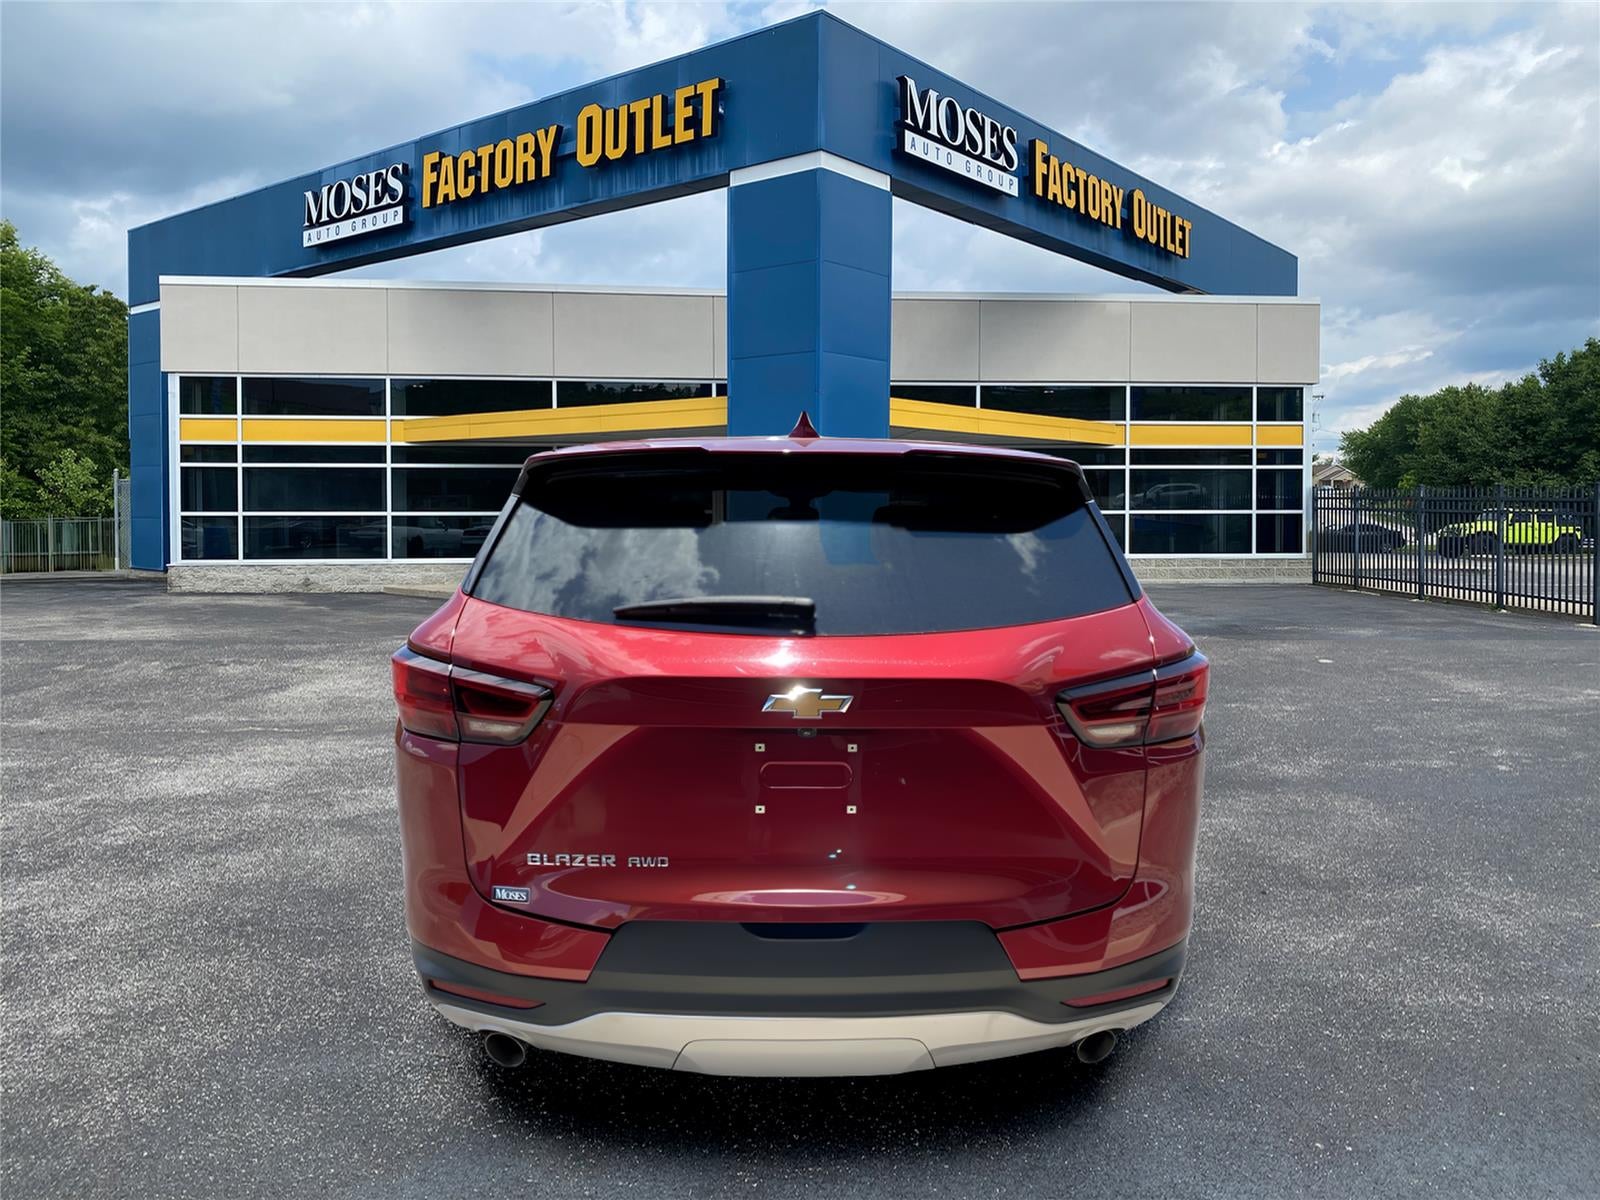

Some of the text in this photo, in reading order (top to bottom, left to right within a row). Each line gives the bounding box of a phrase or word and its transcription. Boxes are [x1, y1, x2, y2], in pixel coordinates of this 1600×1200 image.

[422, 77, 721, 208] FACTORY OUTLET
[903, 75, 1019, 172] MOSES
[303, 163, 405, 227] MOSES
[910, 136, 1015, 191] AUTO GROUP
[306, 210, 402, 243] AUTO GROUP
[1034, 138, 1192, 259] FACTORY OUTLET
[526, 853, 670, 868] BLAZER AWD
